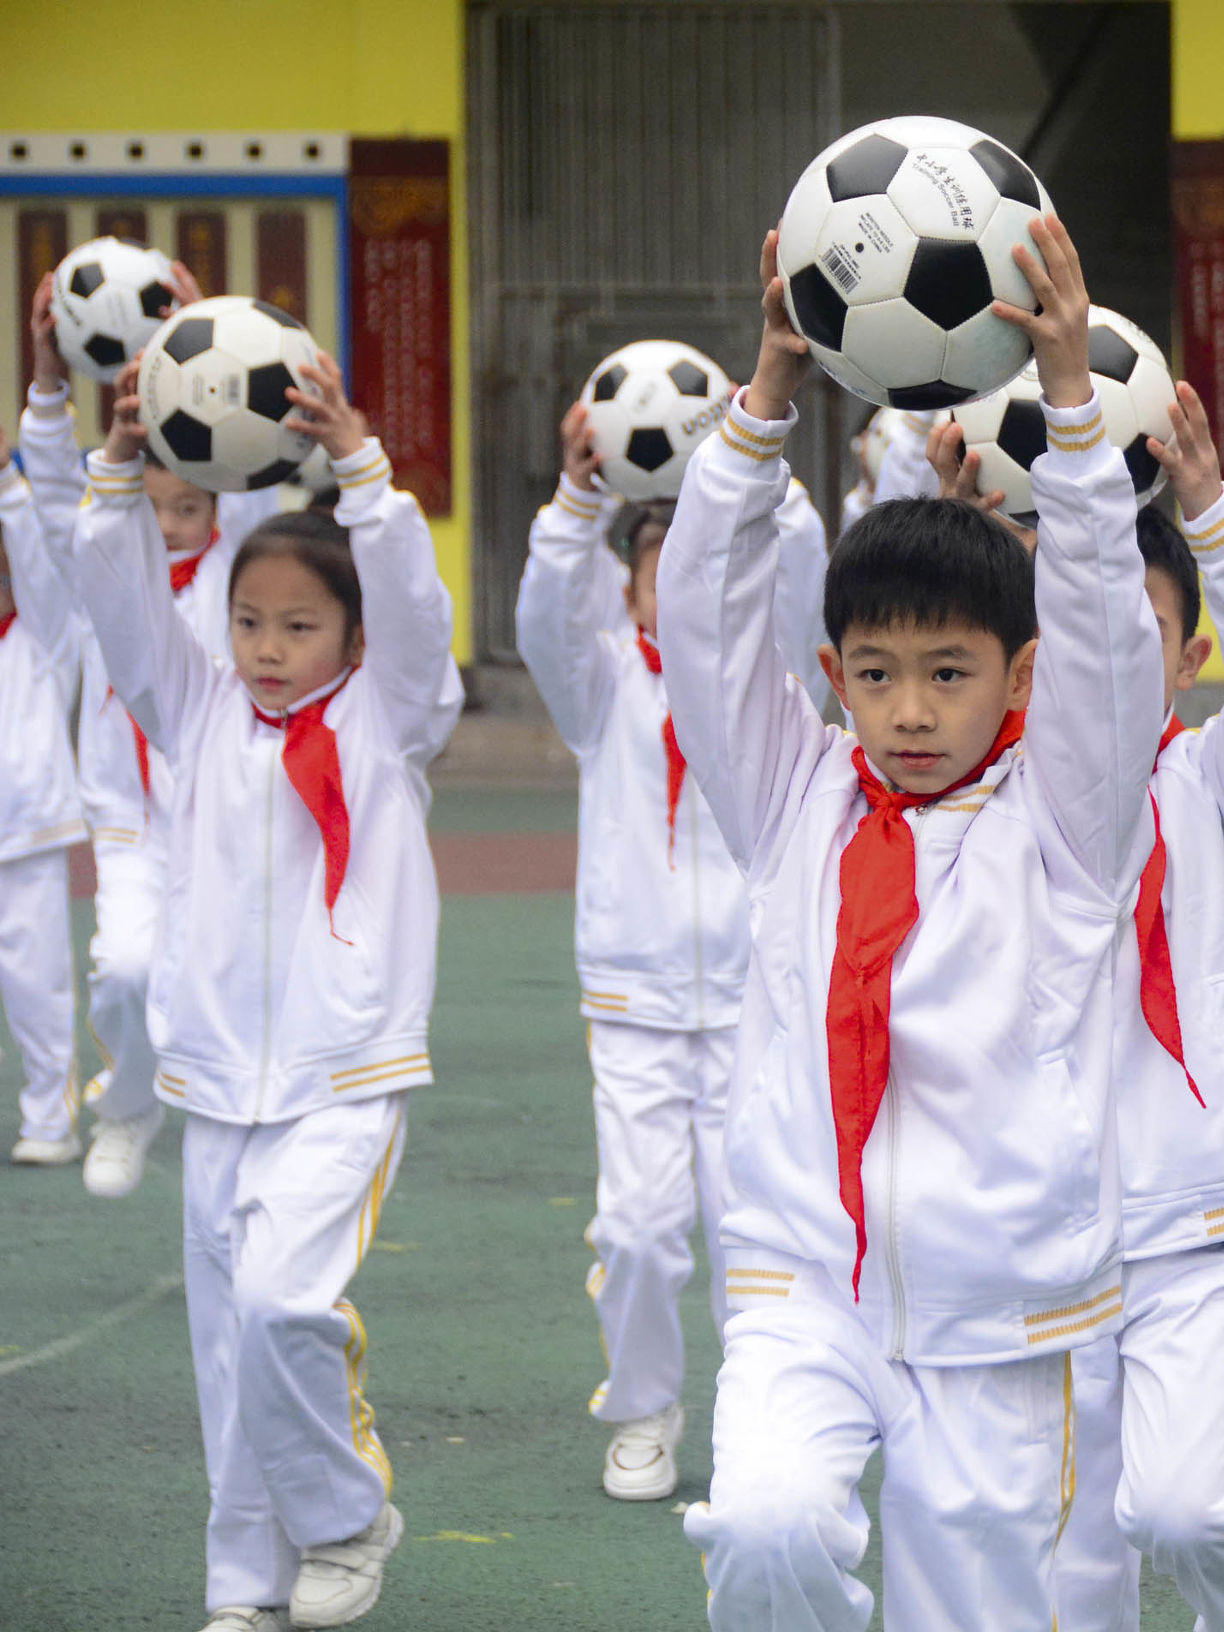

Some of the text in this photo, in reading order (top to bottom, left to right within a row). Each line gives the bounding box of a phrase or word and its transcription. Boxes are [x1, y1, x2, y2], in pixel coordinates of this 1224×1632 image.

[912, 163, 960, 227] Training Soccer Ball
